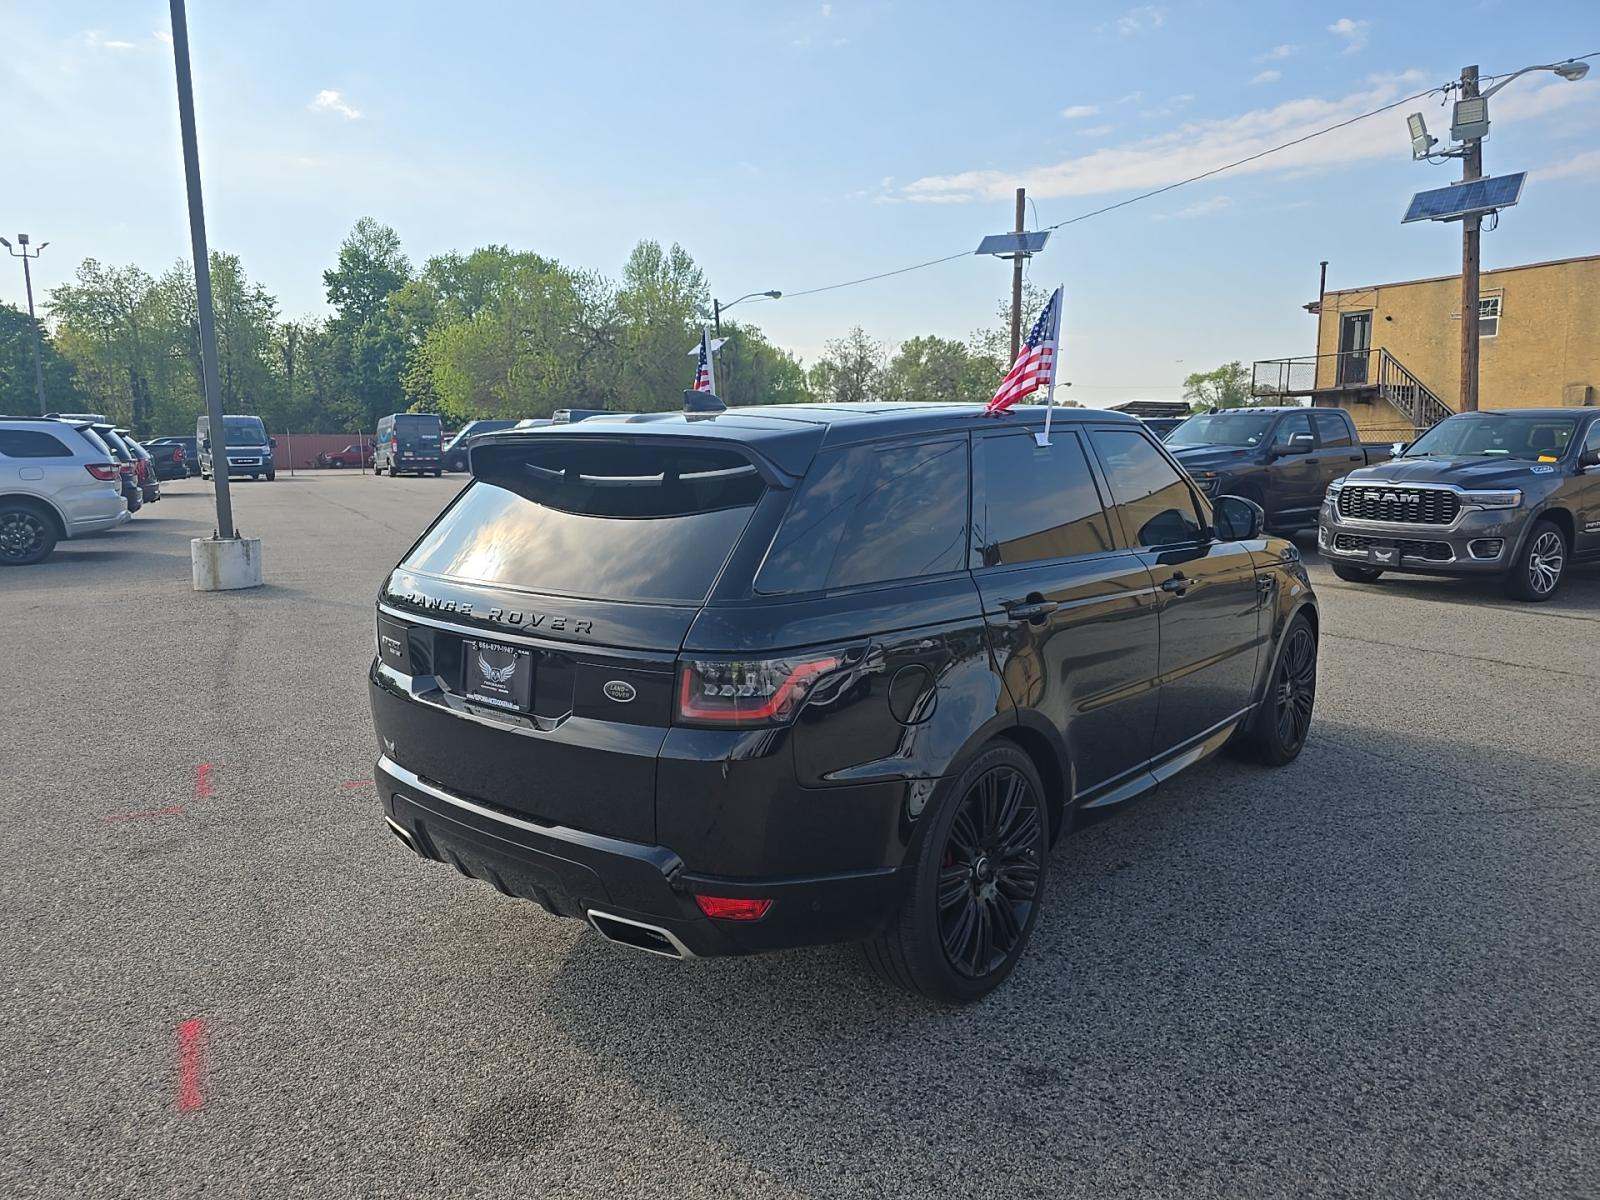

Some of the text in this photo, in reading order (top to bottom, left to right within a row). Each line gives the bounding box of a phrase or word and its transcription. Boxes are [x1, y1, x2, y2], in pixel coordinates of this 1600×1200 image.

[1363, 492, 1420, 503] RAM
[404, 592, 592, 635] RANGE ROVER
